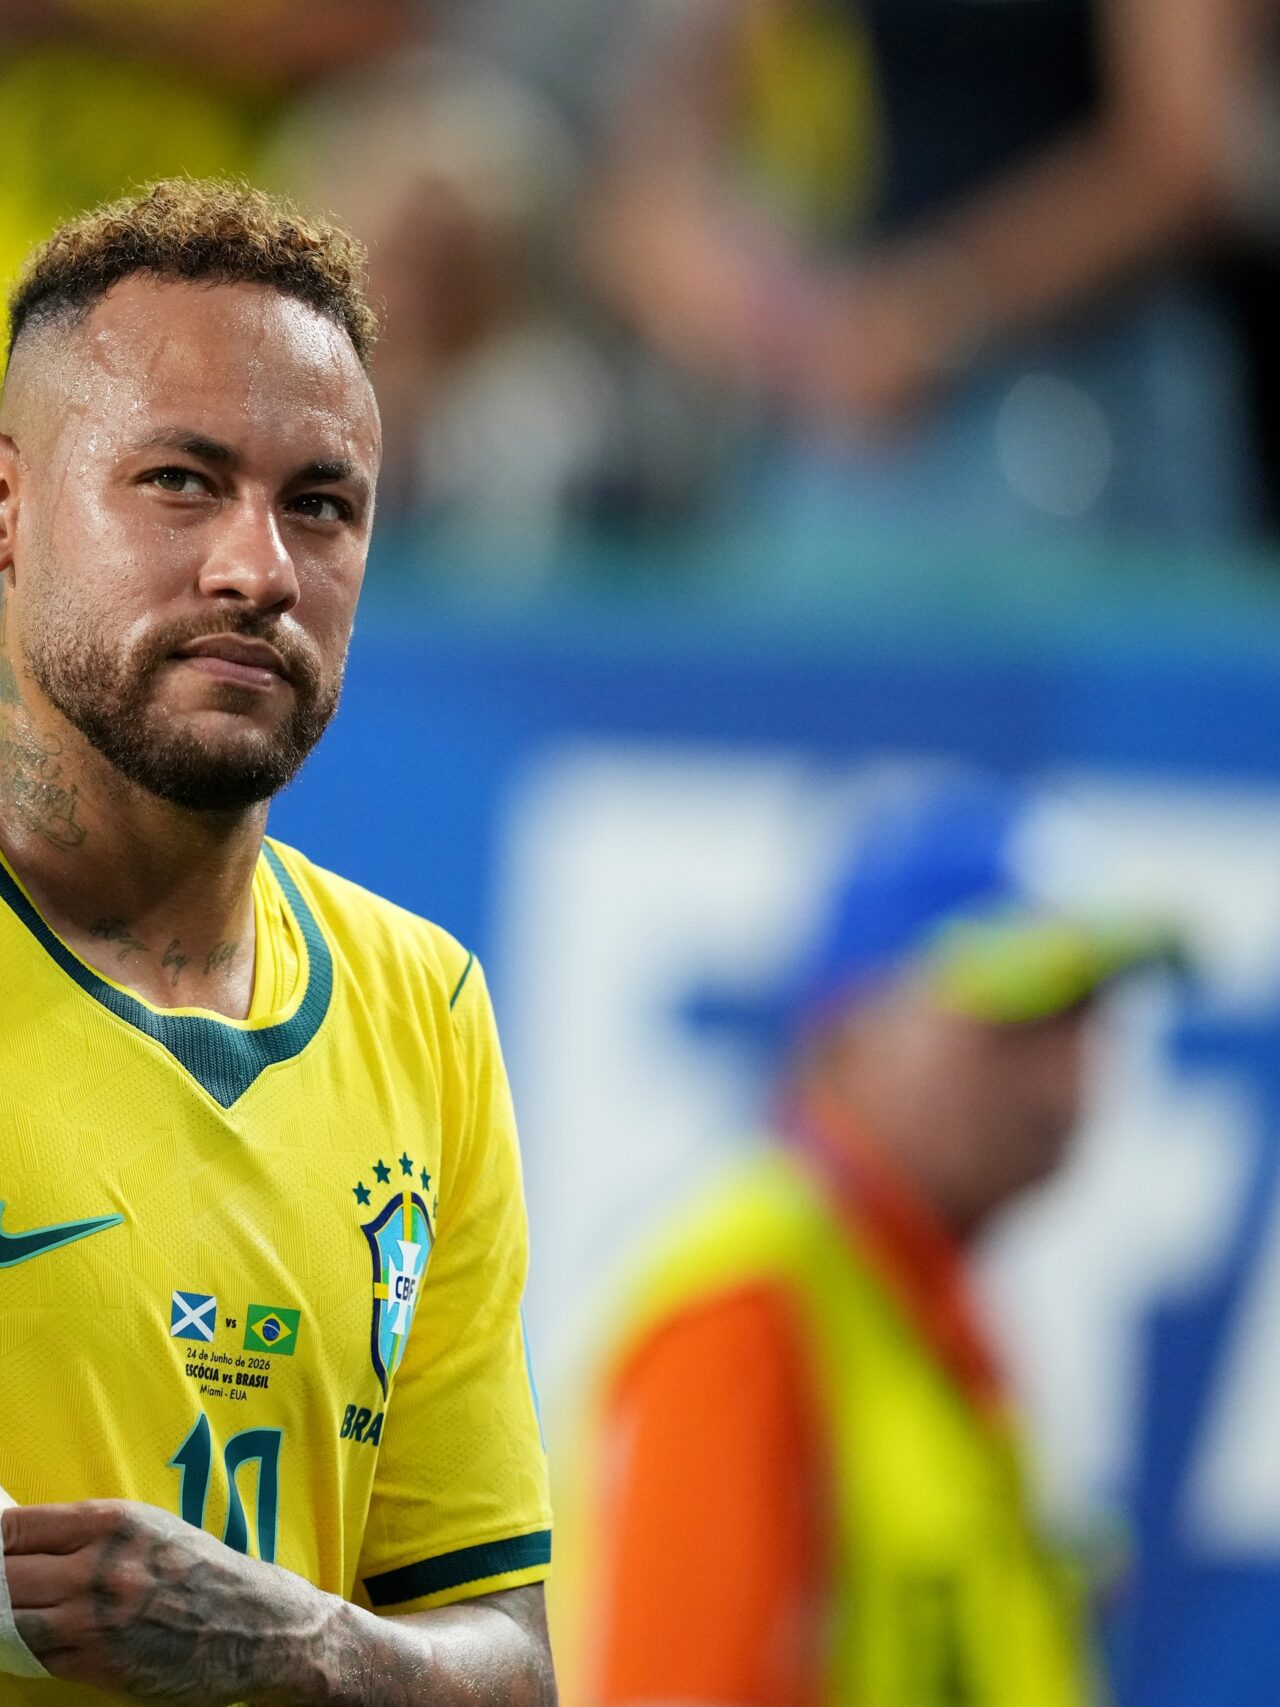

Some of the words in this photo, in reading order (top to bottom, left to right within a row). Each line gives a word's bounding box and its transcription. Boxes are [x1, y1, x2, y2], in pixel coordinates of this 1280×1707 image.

[395, 1275, 416, 1301] CBF
[225, 1317, 237, 1328] vs
[187, 1347, 197, 1359] 24
[198, 1349, 209, 1361] de
[210, 1352, 233, 1365] Junho
[235, 1355, 246, 1367] de
[248, 1357, 271, 1371] 2026
[185, 1362, 219, 1381] ESCÓCIA
[222, 1373, 233, 1384] vs
[235, 1372, 269, 1389] BRASIL
[200, 1384, 223, 1397] Miami
[229, 1388, 247, 1401] EUA
[168, 1411, 284, 1565] 10
